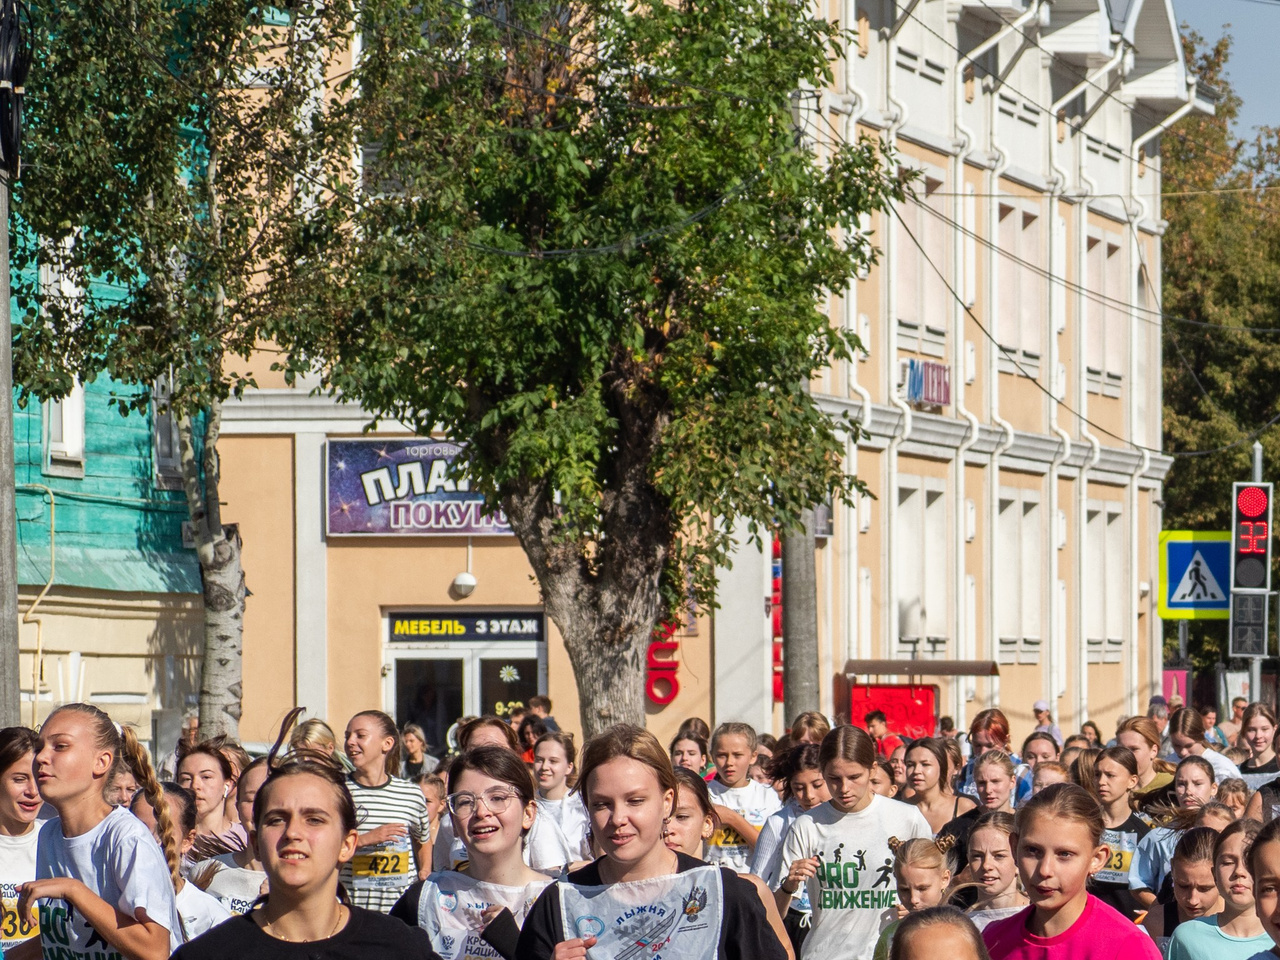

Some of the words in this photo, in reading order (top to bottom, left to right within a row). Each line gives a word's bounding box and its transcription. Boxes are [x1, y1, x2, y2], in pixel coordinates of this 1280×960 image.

[1240, 521, 1268, 553] 32
[394, 620, 466, 635] МЕБЕЛЬ
[475, 619, 488, 634] 3
[490, 619, 537, 634] ЭТАЖ
[369, 855, 400, 875] 422
[816, 860, 859, 889] PRO
[616, 905, 666, 925] ЛЫЖНЯ
[466, 935, 493, 947] КРО
[652, 936, 671, 952] 204
